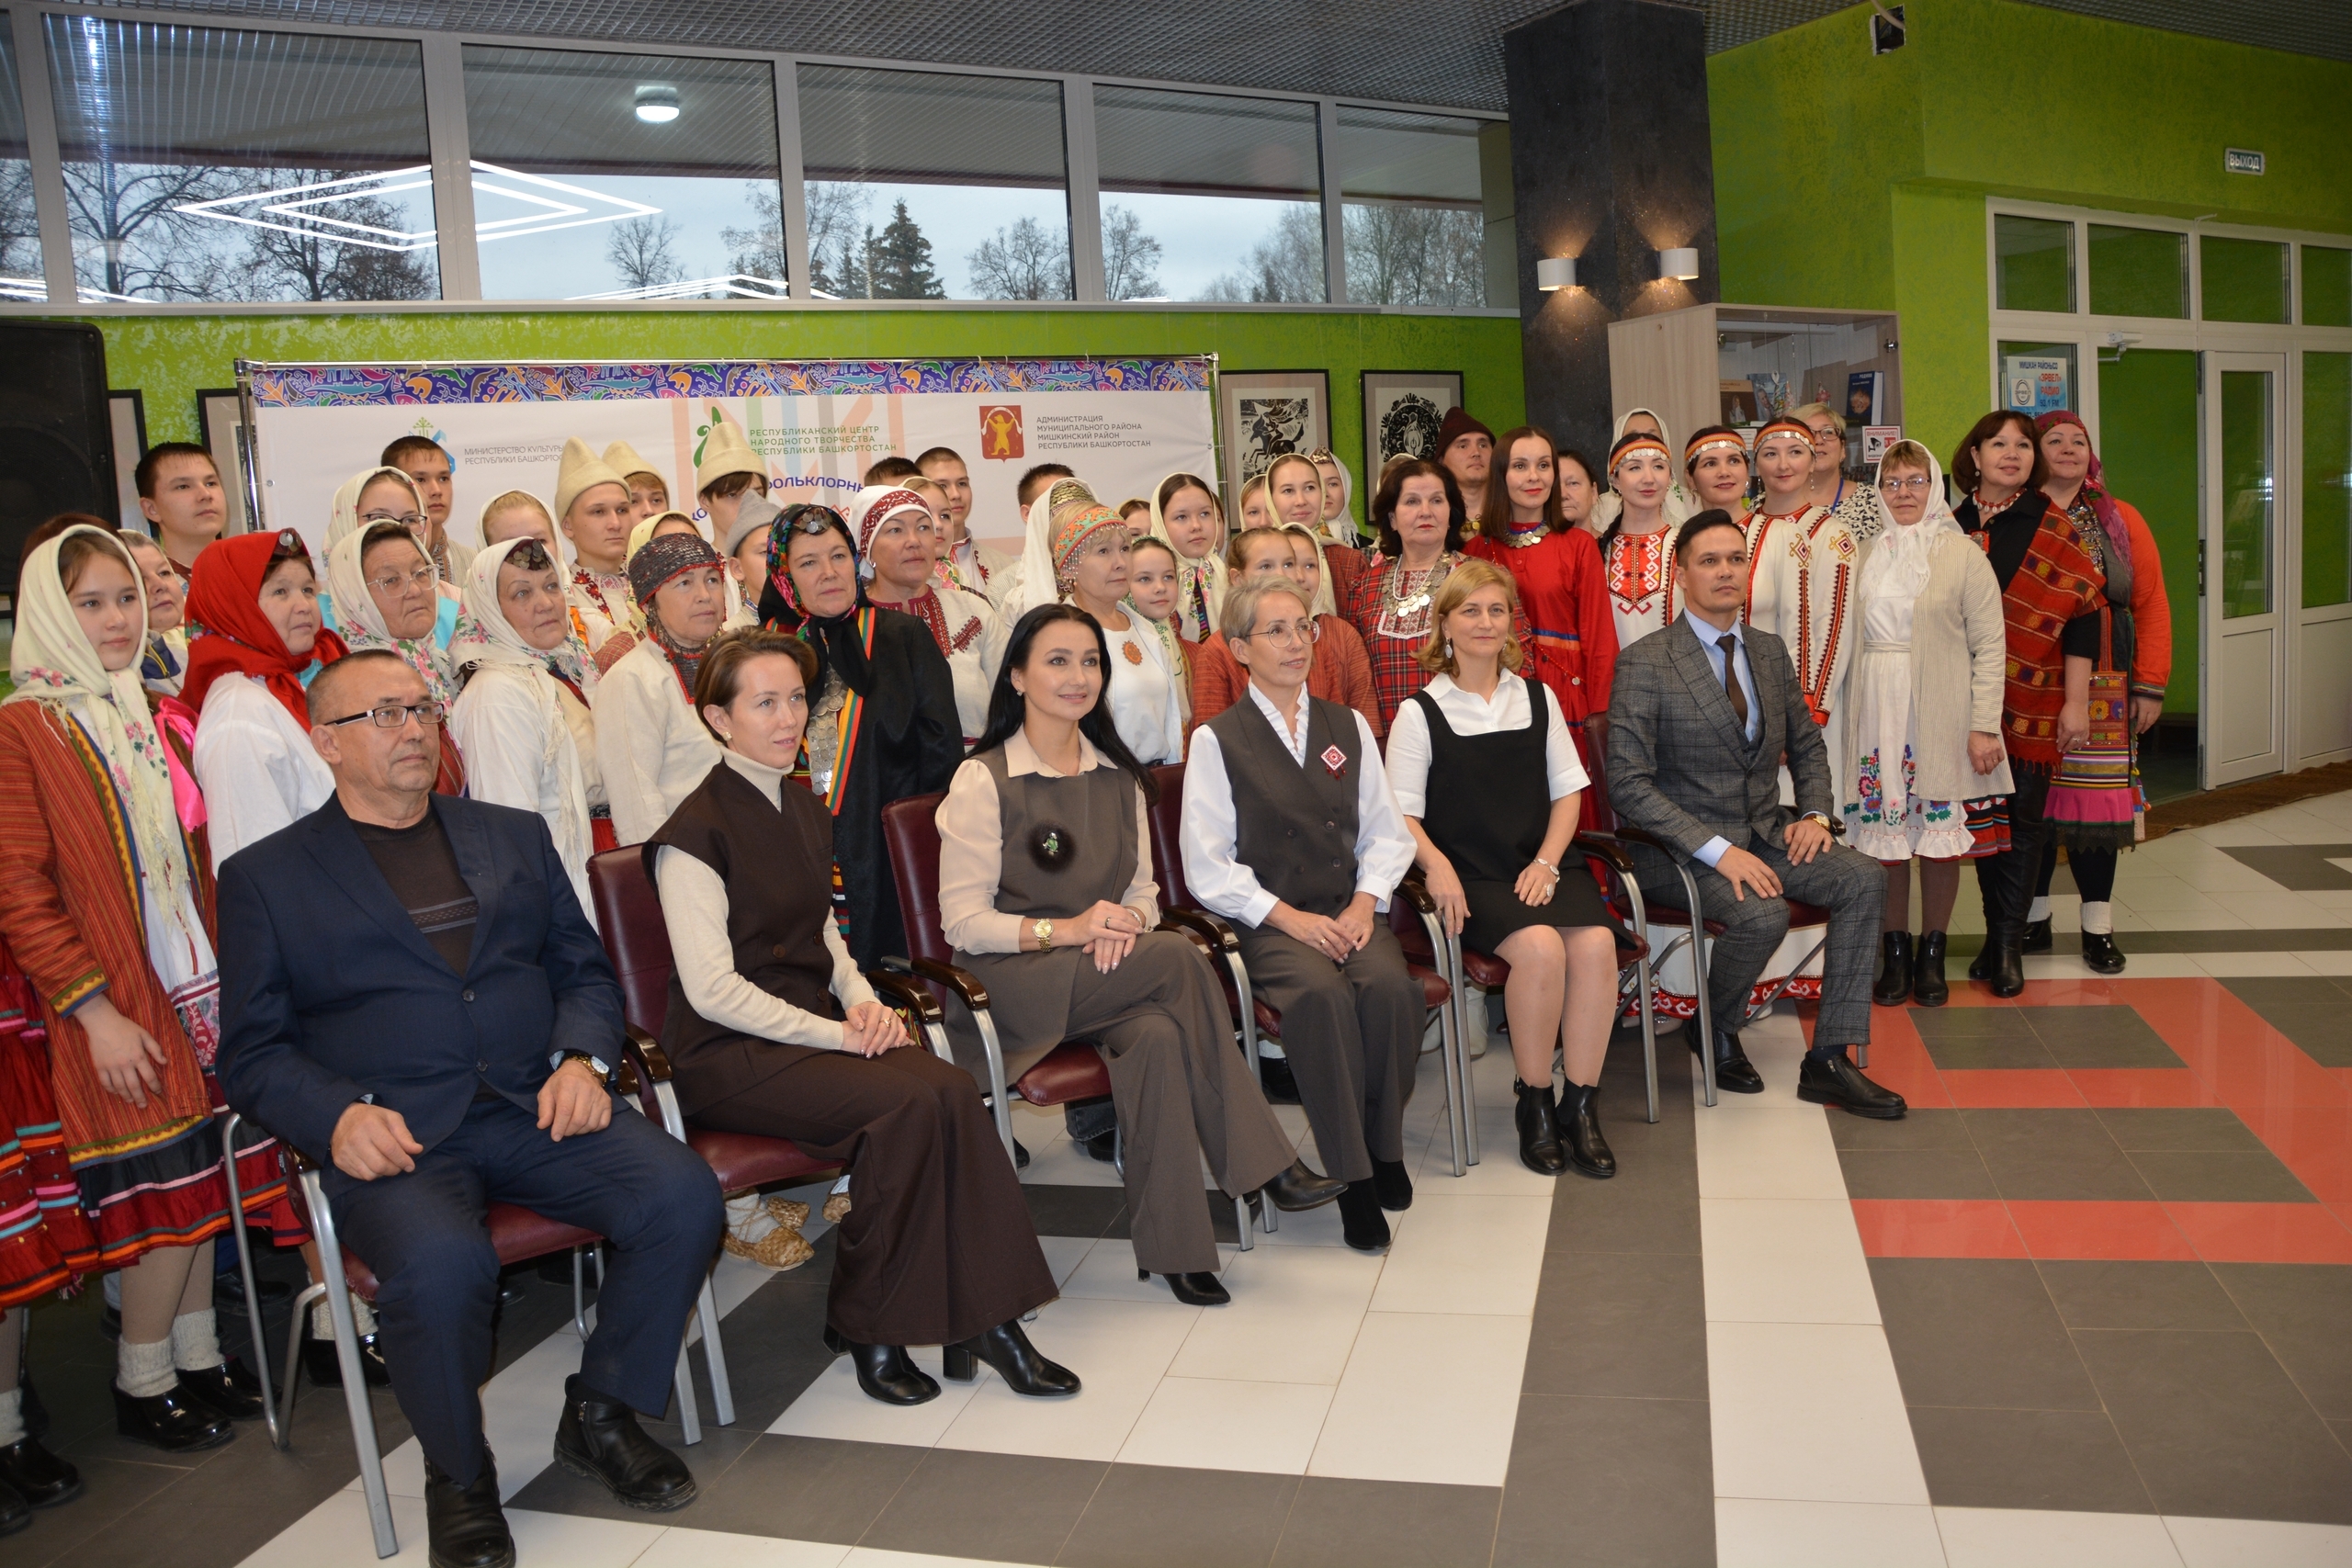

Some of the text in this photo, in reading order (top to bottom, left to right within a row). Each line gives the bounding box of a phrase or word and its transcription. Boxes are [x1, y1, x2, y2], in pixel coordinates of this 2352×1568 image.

[2230, 153, 2259, 170] ВЫХОД
[2041, 386, 2060, 396] РАДИО
[1036, 415, 1103, 423] АДМИНИСТРАЦИЯ
[750, 425, 879, 436] РЕСПУБЛИКАНСКИЙ ЦЕНТР
[1037, 423, 1110, 432] МУНИЦИПАЛЬНОГО
[751, 434, 876, 446] НАРОДНОГО ТВОРЧЕСТВА
[1037, 431, 1120, 441] МИШКИНСКИЙ РАЙОН
[819, 444, 897, 454] БАШКОРТОСТАН
[1038, 440, 1151, 450] РЕСПУБЛИКИ БАШКОРТОСТАН
[464, 446, 526, 456] МИНИСТЕРСТВО
[465, 456, 516, 465] РЕСПУБЛИКИ
